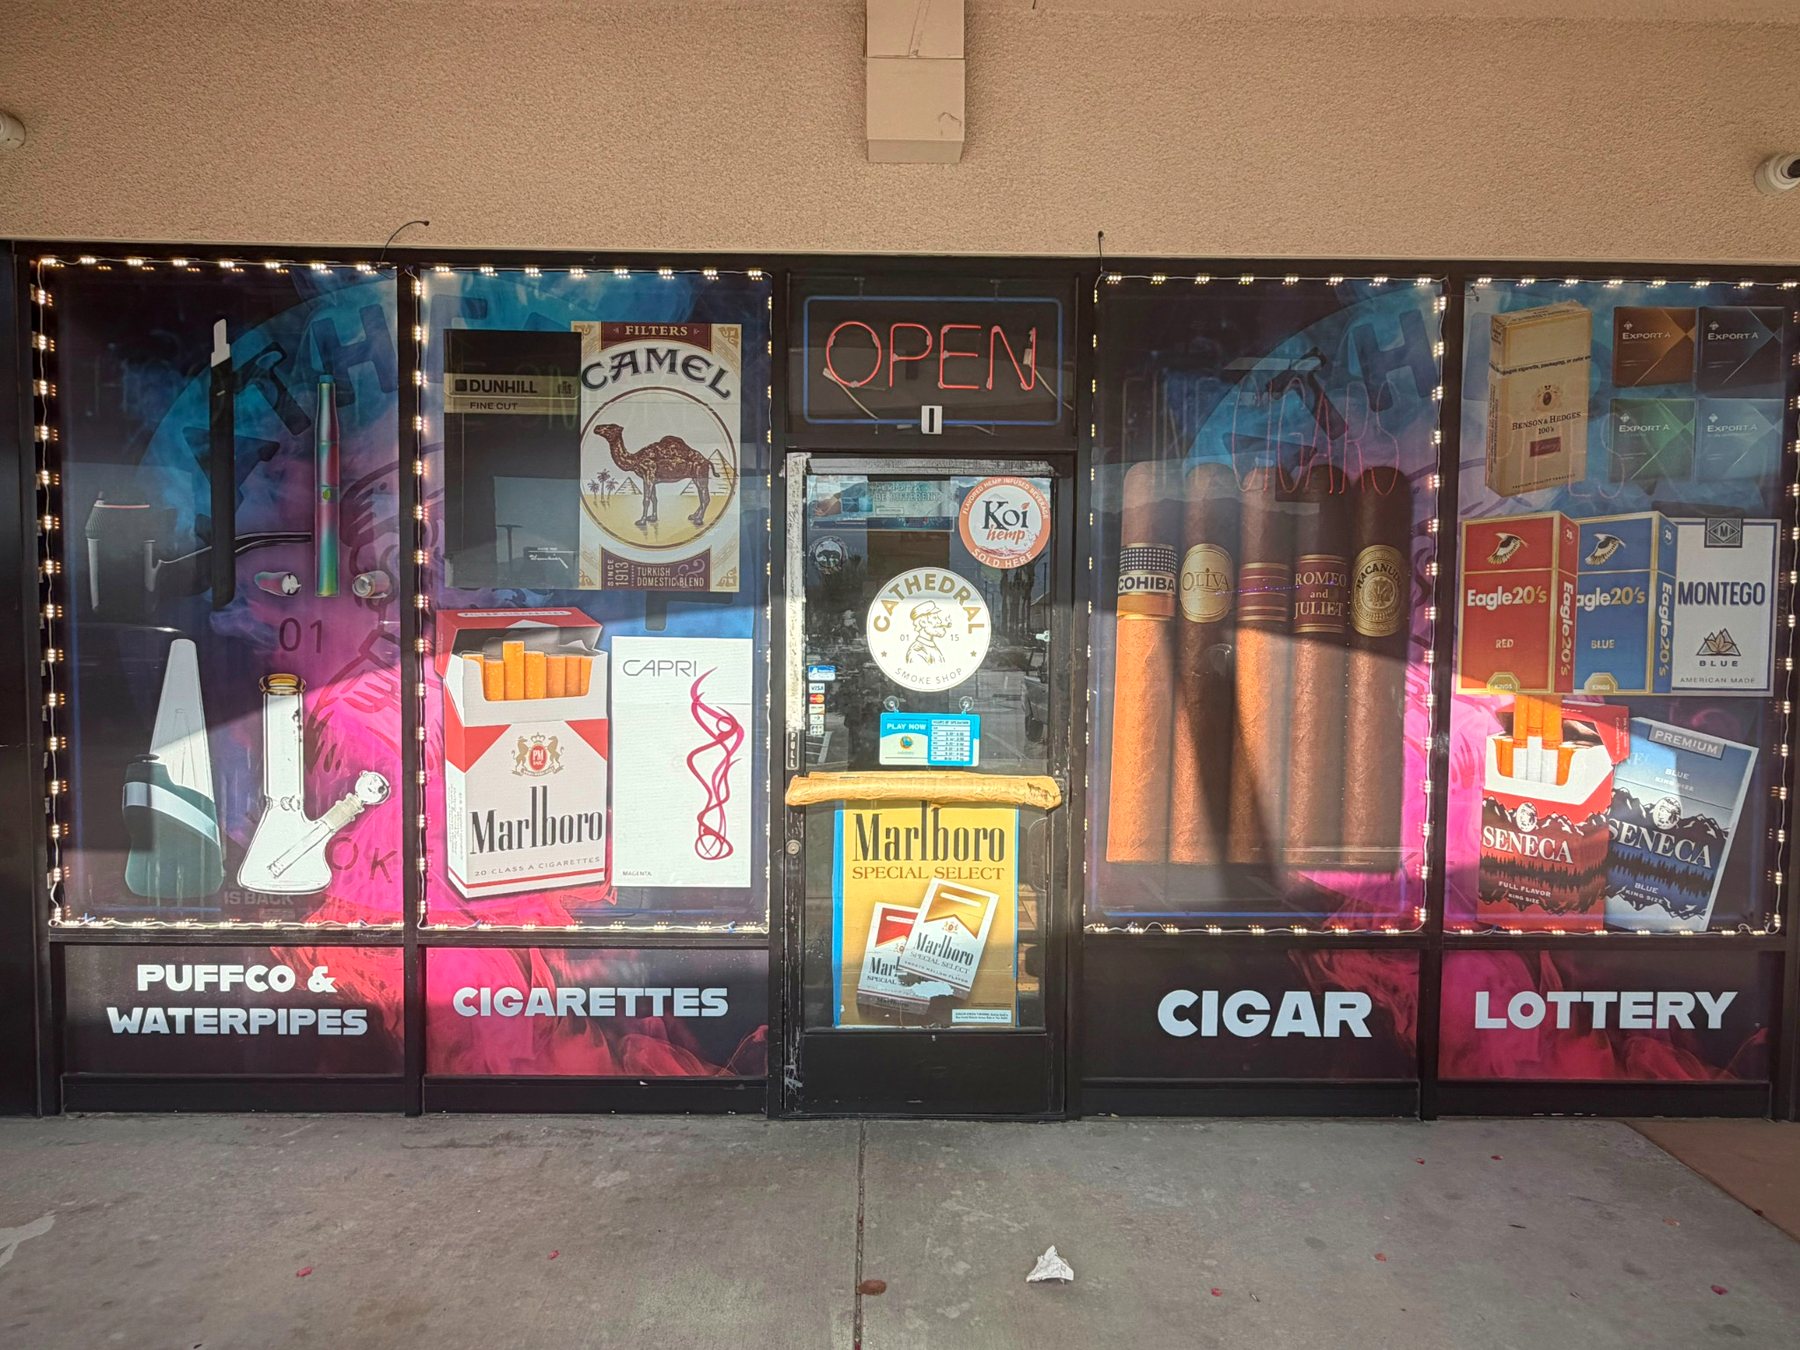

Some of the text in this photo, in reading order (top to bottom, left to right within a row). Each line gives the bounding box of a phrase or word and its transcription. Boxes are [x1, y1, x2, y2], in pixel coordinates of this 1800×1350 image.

[624, 325, 688, 337] FILTERS
[1622, 332, 1663, 340] EXPORT
[1707, 331, 1759, 341] EXPORT A
[825, 320, 1037, 391] OPEN
[580, 346, 732, 400] CAMEL
[470, 379, 537, 394] DUNHILL
[470, 402, 519, 411] FINE CUT
[1549, 411, 1582, 424] HEDGES
[1618, 424, 1661, 433] EXPORT
[1707, 424, 1750, 433] EXPORT
[981, 500, 1031, 531] Koi
[986, 523, 1026, 545] hemp
[972, 548, 1034, 569] SOLD HERE
[607, 559, 615, 587] SINCE
[615, 561, 629, 587] 1913
[637, 567, 671, 576] TURKISH
[1295, 571, 1347, 587] ROMEO
[636, 577, 705, 588] DOMESTIC BLEND
[1117, 575, 1175, 593] COHIBA
[1310, 589, 1329, 599] and
[1467, 585, 1547, 611] Eagle20's
[1577, 586, 1646, 612] agle20's
[1677, 580, 1766, 606] MONTEGO
[873, 573, 985, 635] CATHEDRAL
[1294, 601, 1344, 620] JULIET
[899, 634, 960, 642] 01 15
[1559, 581, 1574, 676] Eagle20's
[1658, 582, 1673, 677] Eagle20's
[1495, 639, 1514, 649] RED
[1591, 639, 1615, 649] BLUE
[622, 659, 697, 678] CAPRI
[894, 667, 963, 686] SMOKE SHOP
[886, 722, 927, 731] PLAY NOW
[1654, 730, 1719, 755] PREMIUM
[1664, 768, 1691, 780] BLUE
[469, 784, 604, 855] Marlboro
[851, 801, 1006, 863] Marlboro
[1482, 825, 1574, 864] SENECA
[1608, 818, 1713, 870] SENECA
[491, 865, 525, 875] CLASS
[538, 856, 601, 870] CIGARETTES
[851, 866, 1005, 881] SPECIAL SELECT
[1498, 880, 1552, 898] FULL FLAVOR
[1625, 889, 1644, 899] KING
[1634, 881, 1659, 895] BLUE
[1508, 893, 1540, 904] KING SIZE
[914, 931, 975, 967] Marlboro
[136, 963, 338, 993] PUFFCO &
[452, 986, 730, 1018] CIGARETTES
[1474, 990, 1739, 1030] LOTTERY
[105, 1006, 369, 1037] WATERPIPES
[1156, 988, 1374, 1039] CIGAR
